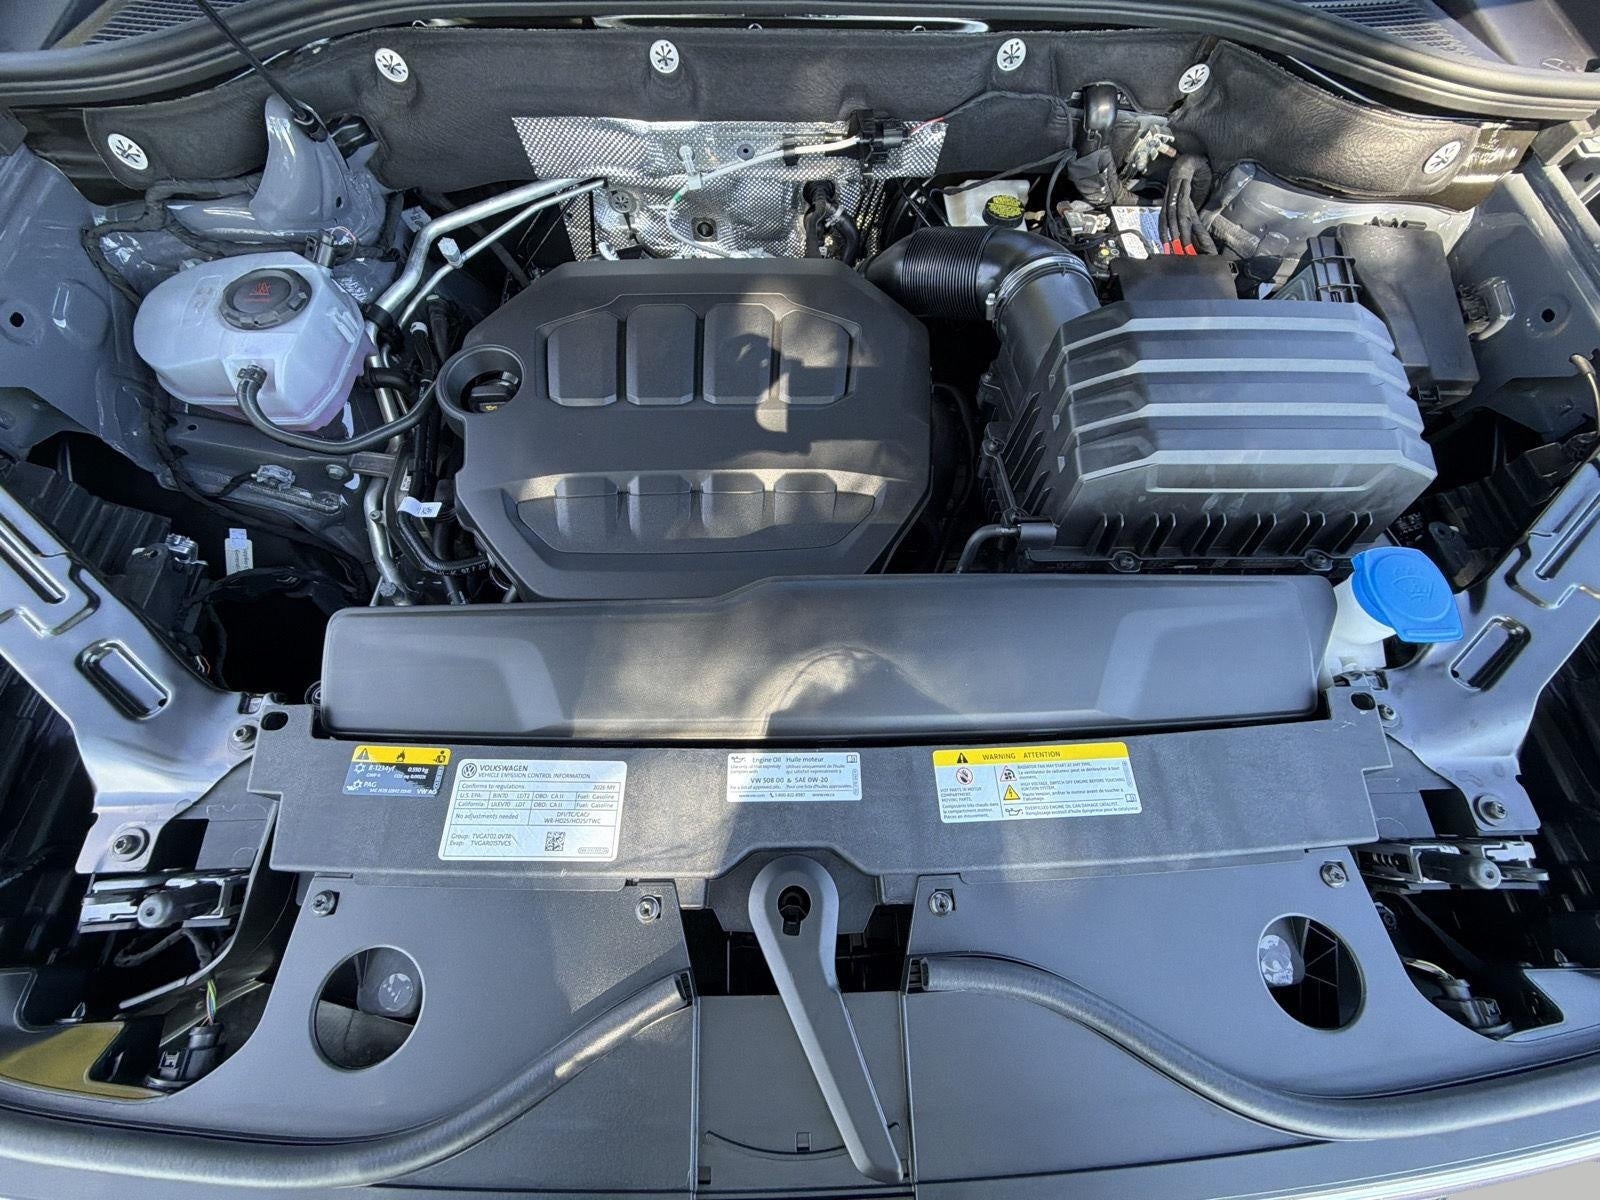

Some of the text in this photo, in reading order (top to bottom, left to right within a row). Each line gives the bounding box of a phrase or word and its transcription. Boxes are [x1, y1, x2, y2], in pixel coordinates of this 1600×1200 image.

[982, 750, 1061, 761] WARNING ATTENTION
[368, 764, 395, 774] R-1234yf
[479, 764, 529, 772] VOLKSWAGEN
[464, 812, 498, 820] adjustments
